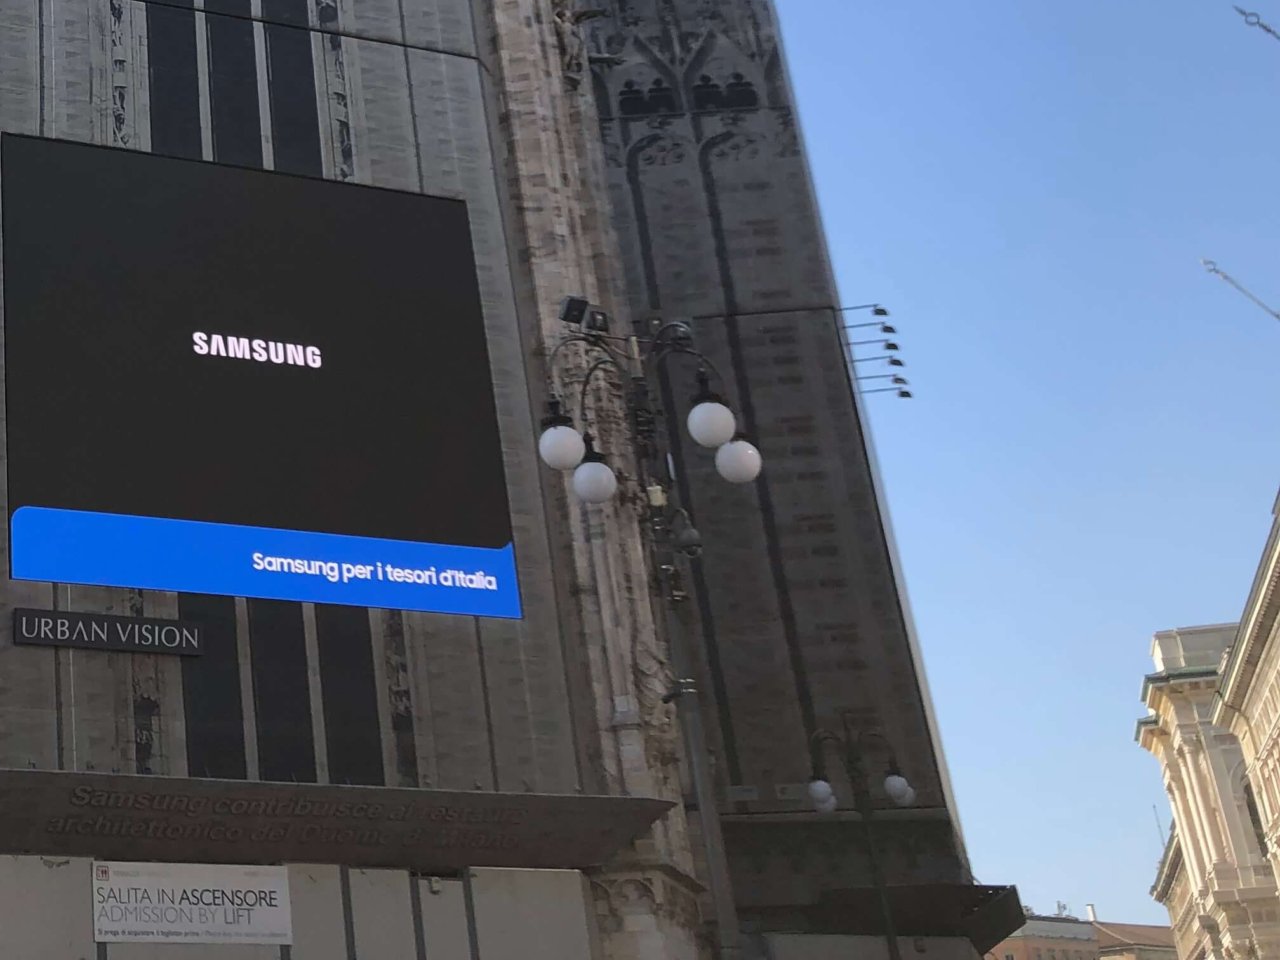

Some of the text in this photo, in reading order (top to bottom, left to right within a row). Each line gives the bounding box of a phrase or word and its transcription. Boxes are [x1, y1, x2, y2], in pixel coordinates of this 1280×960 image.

[192, 331, 322, 368] SAMSUNG
[252, 552, 497, 590] Samsung per i tesori d'Italia
[22, 616, 198, 648] URBAN VISION
[71, 785, 208, 816] Samsung
[214, 795, 384, 820] contribuisce
[97, 887, 278, 907] SALITA IN ASCENSORE
[97, 906, 254, 925] ADMISSION BY LIFT
